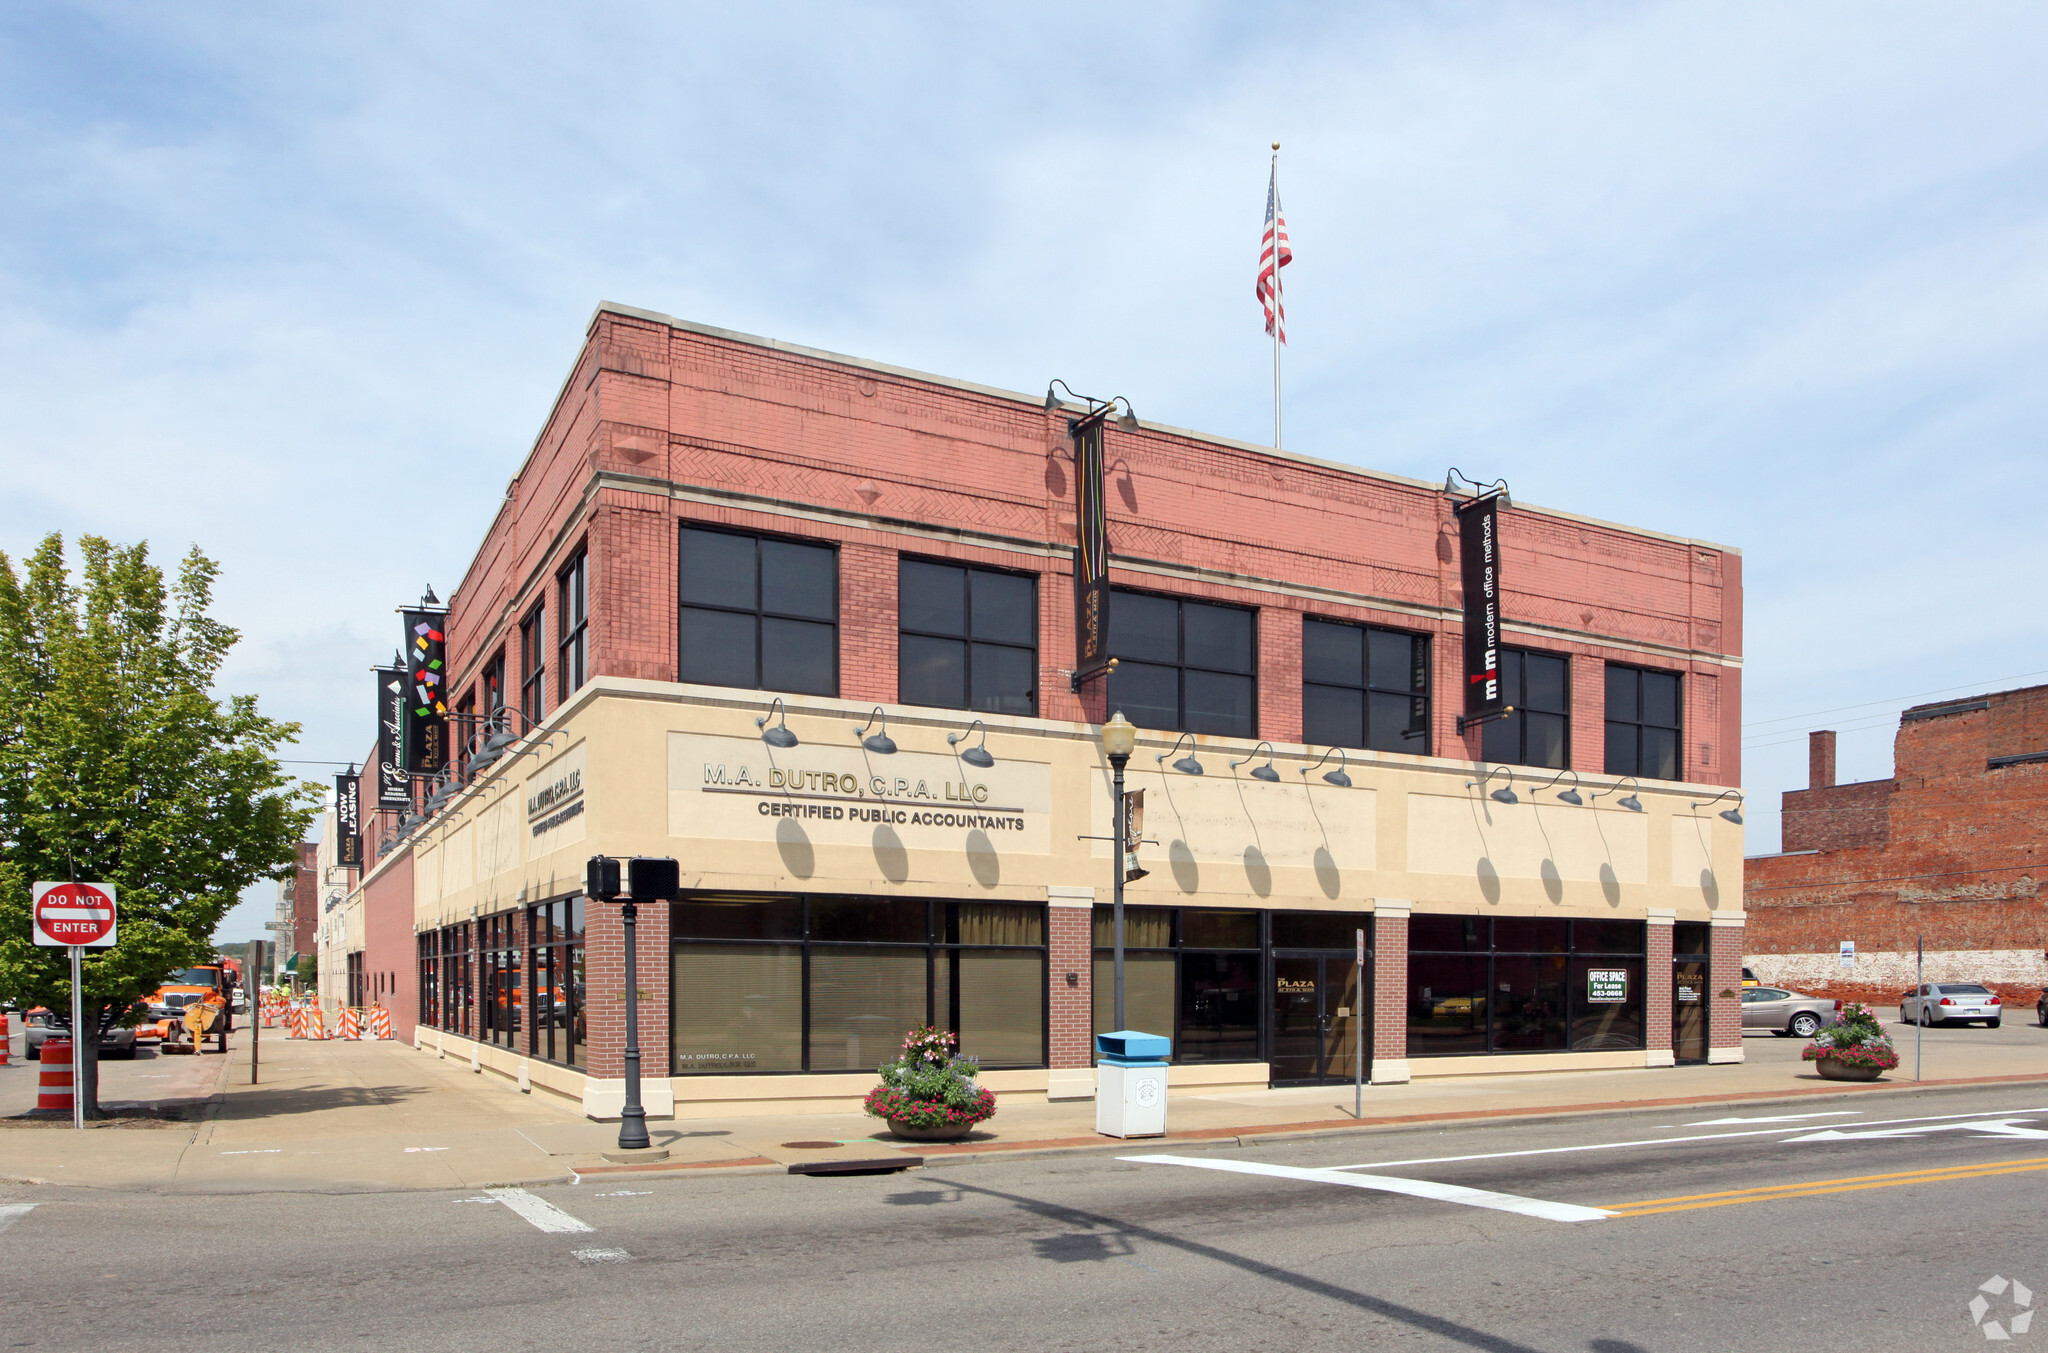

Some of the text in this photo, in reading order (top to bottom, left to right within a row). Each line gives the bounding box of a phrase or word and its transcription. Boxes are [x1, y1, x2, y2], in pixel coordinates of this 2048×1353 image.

[1482, 514, 1492, 563] methods
[1483, 566, 1493, 598] office
[1486, 602, 1495, 647] modern
[383, 696, 401, 740] Associates
[392, 740, 401, 749] &
[425, 724, 433, 768] PLAZA
[569, 768, 581, 791] LLC
[703, 763, 989, 802] M.A. DUTRO, C.P.A. LLC
[340, 793, 348, 823] NOW
[348, 782, 357, 835] LEASING
[758, 802, 1025, 831] CERTIFIED PUBLIC ACCOUNTANTS
[48, 894, 103, 905] DO NOT
[53, 922, 98, 933] ENTER
[1590, 971, 1626, 982] OFFICE SPACE
